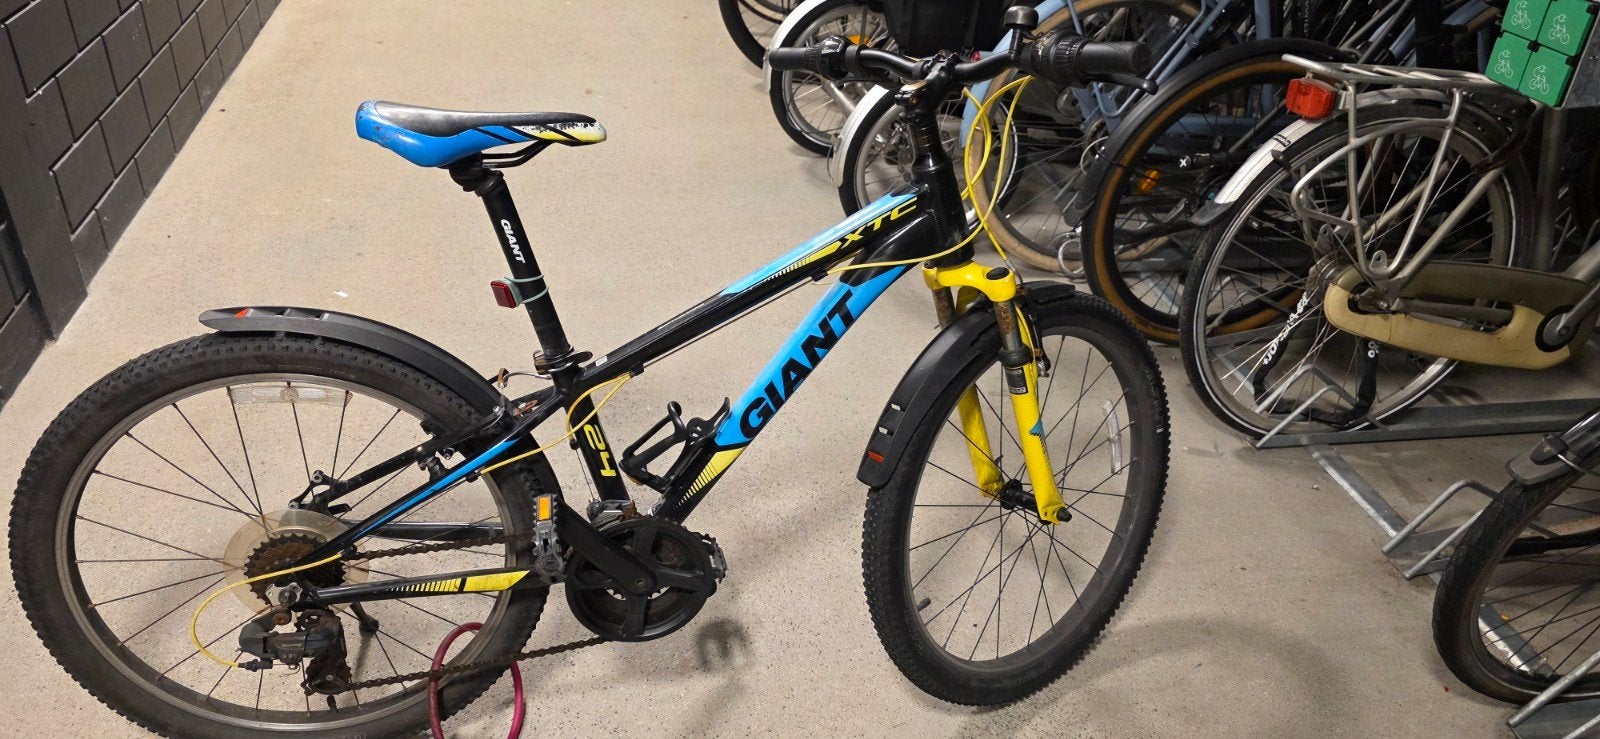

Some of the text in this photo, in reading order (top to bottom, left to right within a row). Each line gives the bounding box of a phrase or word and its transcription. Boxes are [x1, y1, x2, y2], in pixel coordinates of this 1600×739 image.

[501, 219, 525, 263] GIANT
[841, 197, 917, 249] XTC
[739, 289, 856, 439] GIANT
[584, 424, 616, 476] 24
